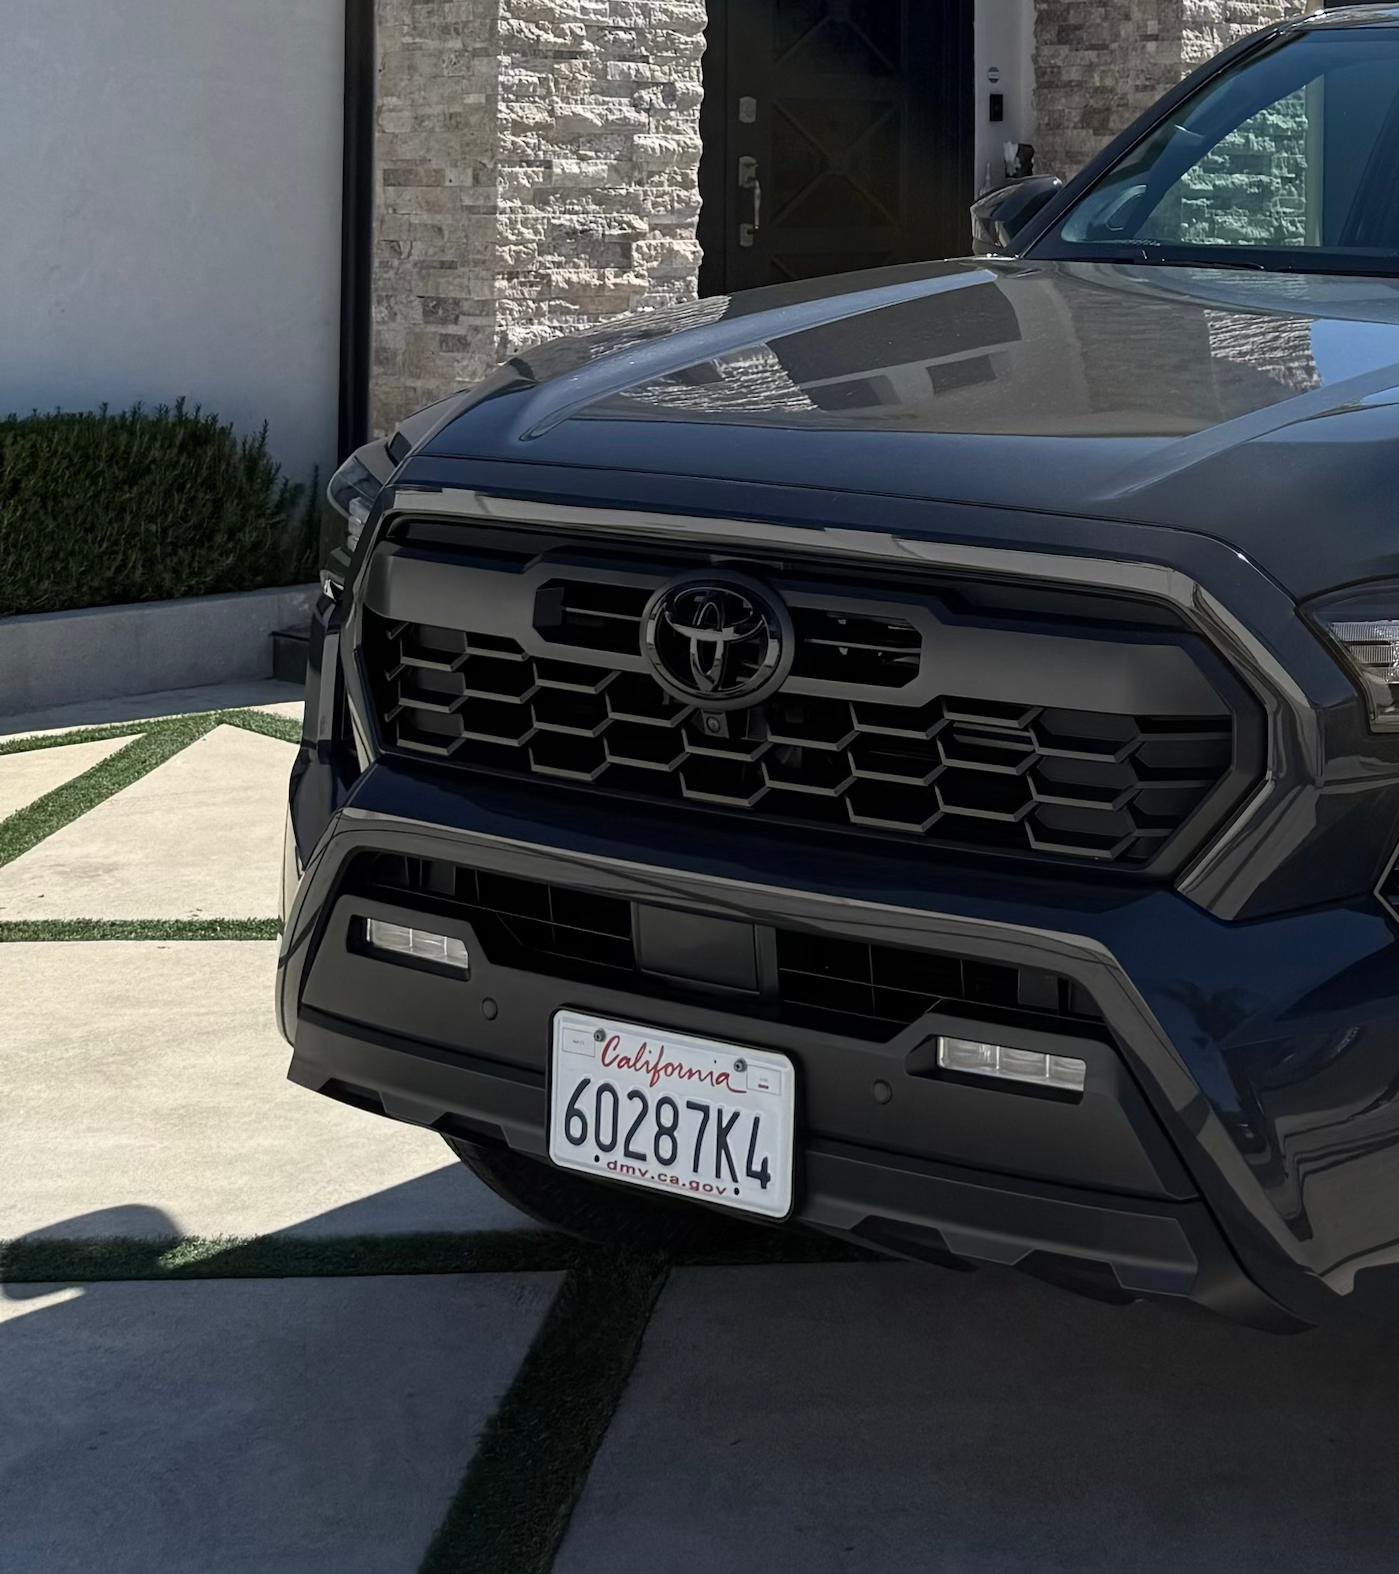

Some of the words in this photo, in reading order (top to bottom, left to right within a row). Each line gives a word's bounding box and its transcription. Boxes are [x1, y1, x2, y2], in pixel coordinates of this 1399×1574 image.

[601, 1035, 747, 1094] California
[564, 1077, 771, 1190] 60287K4
[606, 1160, 727, 1196] dmv.ca.gov
